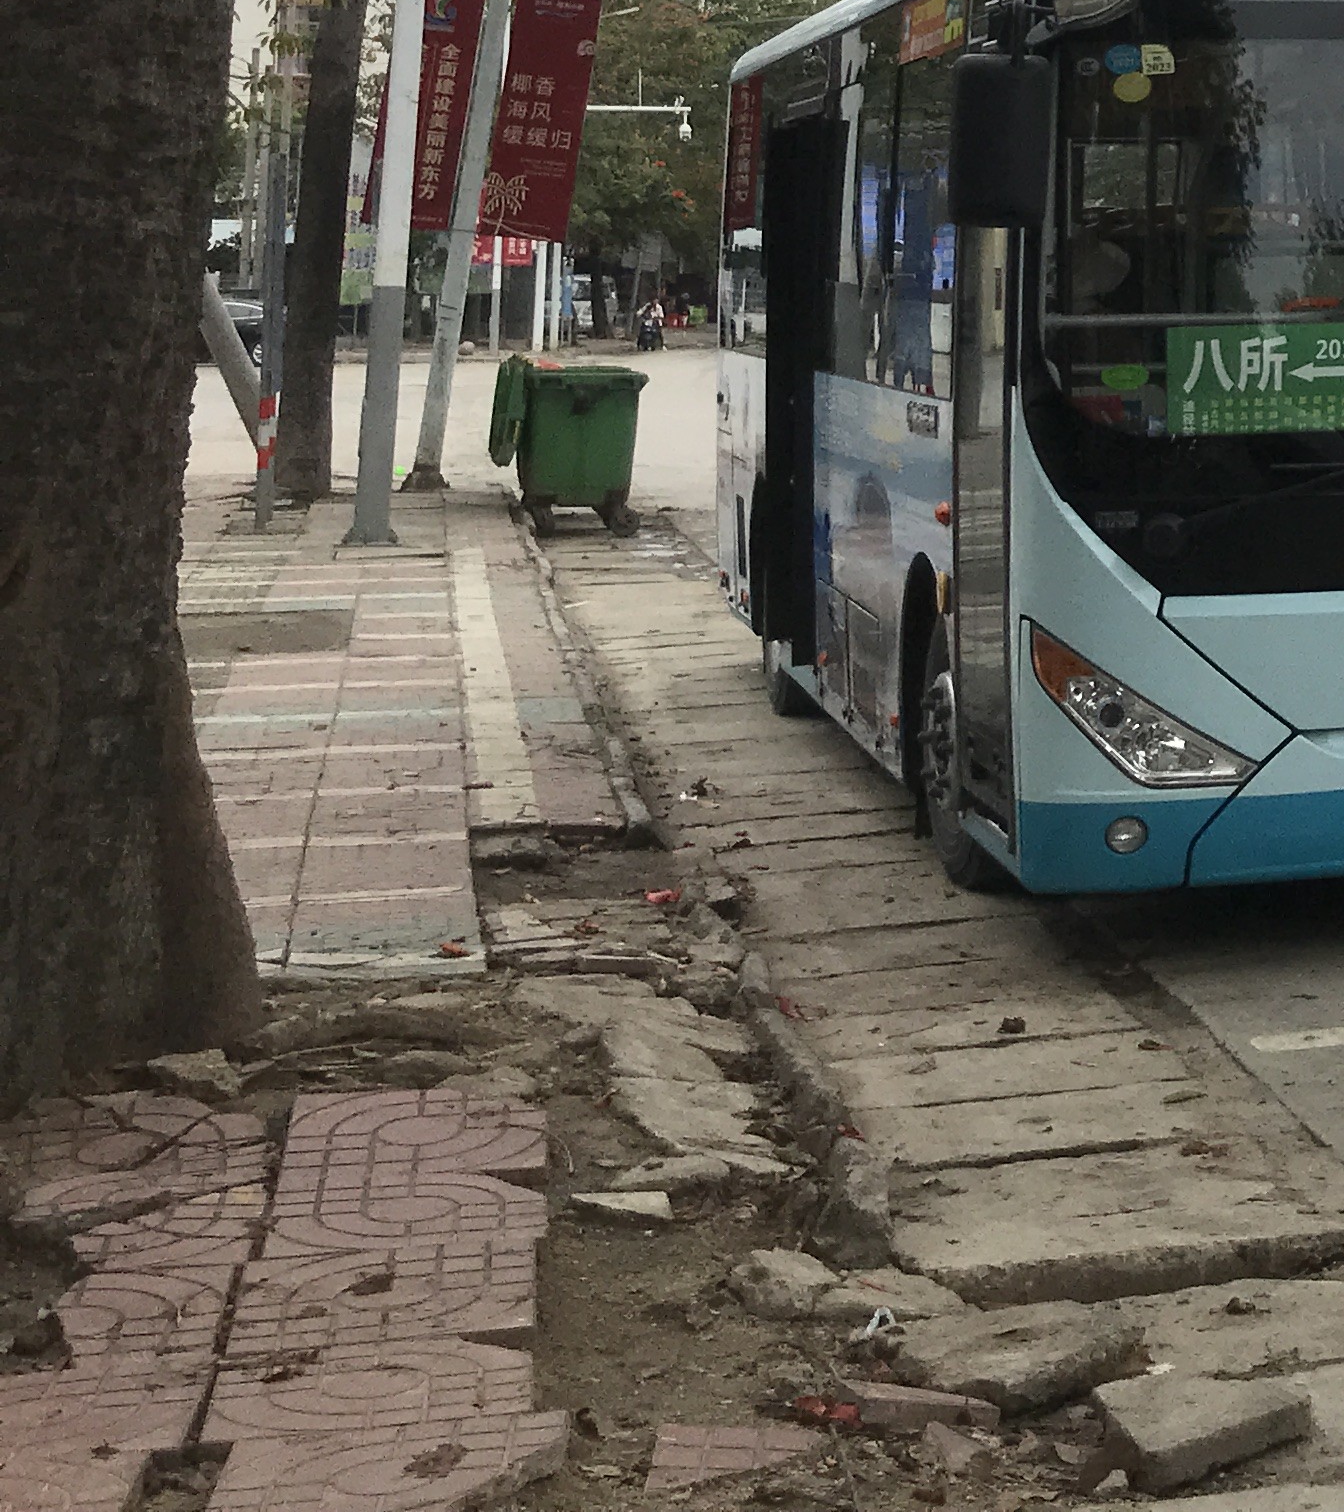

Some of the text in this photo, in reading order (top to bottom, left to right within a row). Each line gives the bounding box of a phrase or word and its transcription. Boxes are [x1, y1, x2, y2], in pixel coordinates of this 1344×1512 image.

[511, 72, 556, 96] 椰香
[418, 42, 462, 201] 全面建设美丽新东方
[506, 98, 552, 122] 海风
[1183, 335, 1289, 394] 八所
